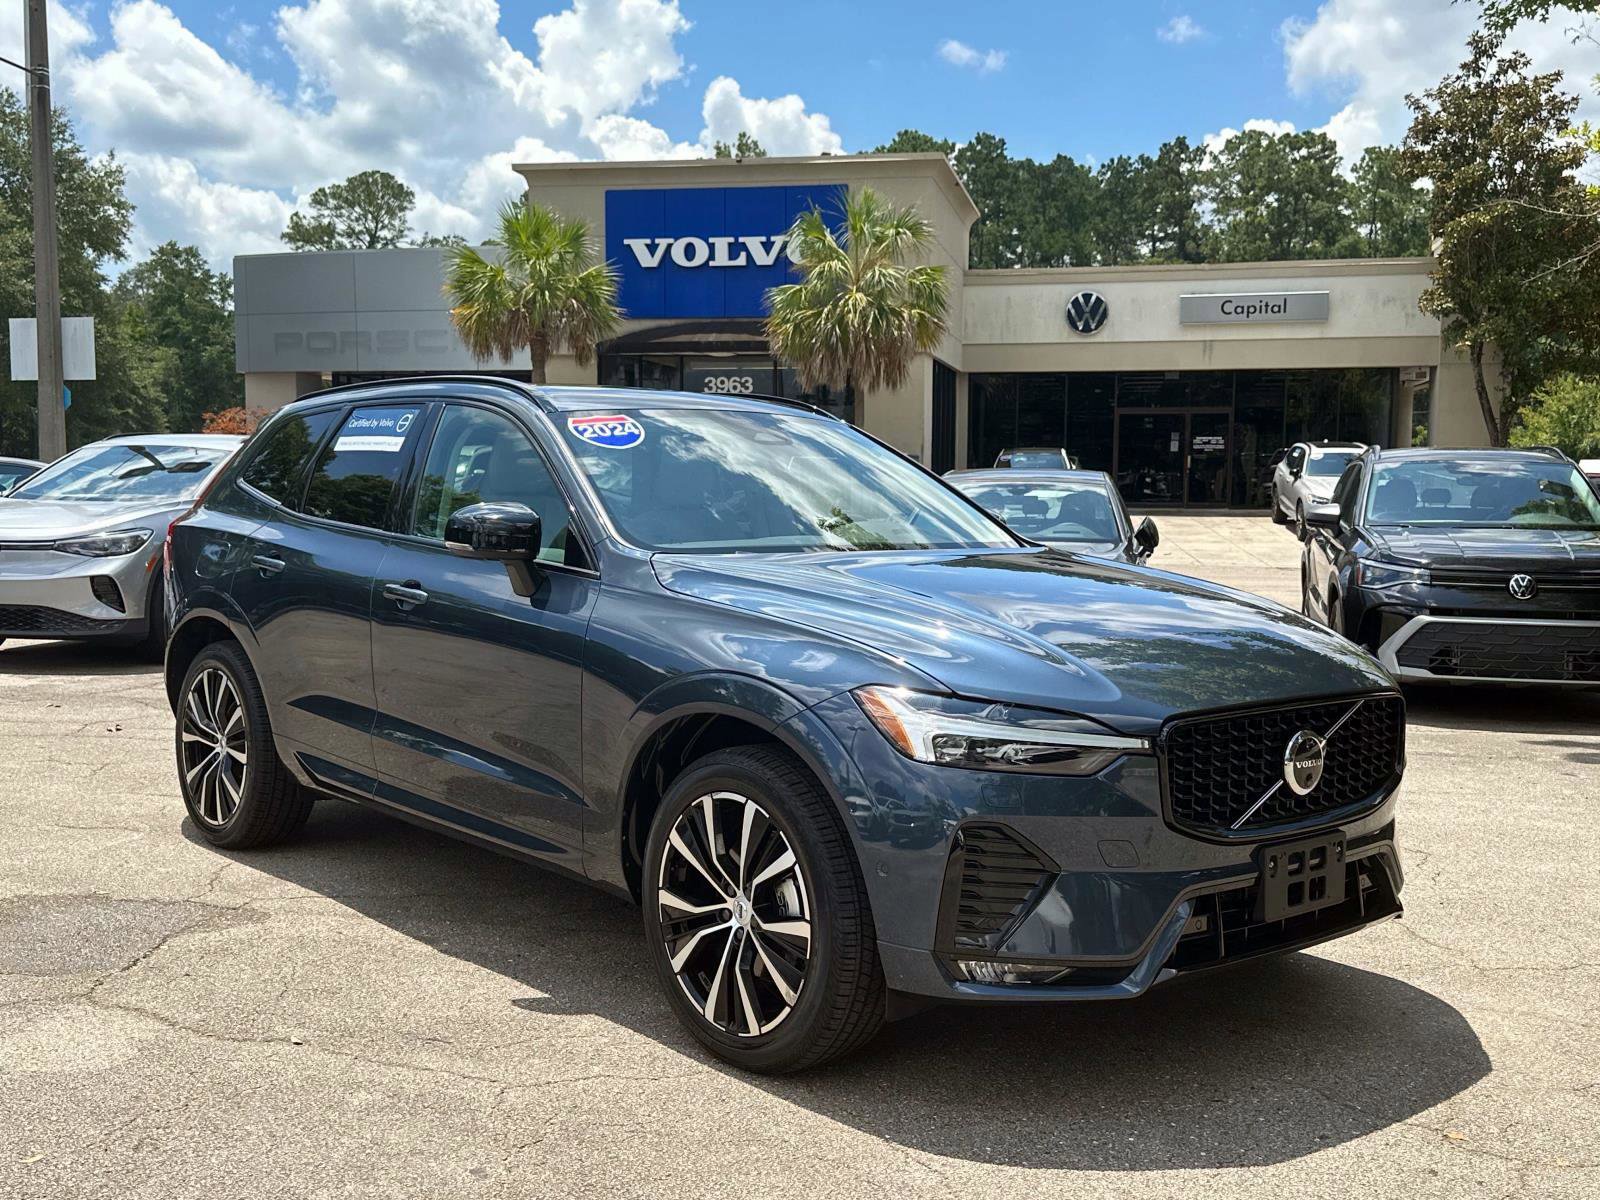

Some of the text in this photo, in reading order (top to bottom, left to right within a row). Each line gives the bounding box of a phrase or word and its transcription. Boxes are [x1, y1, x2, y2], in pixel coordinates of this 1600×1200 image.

[1220, 297, 1287, 319] Capital
[274, 330, 458, 354] PORSC
[703, 376, 754, 394] 3963
[348, 418, 371, 429] Certified
[379, 418, 395, 428] Volvo
[577, 422, 641, 438] 2024
[1295, 758, 1322, 769] VOLVO
